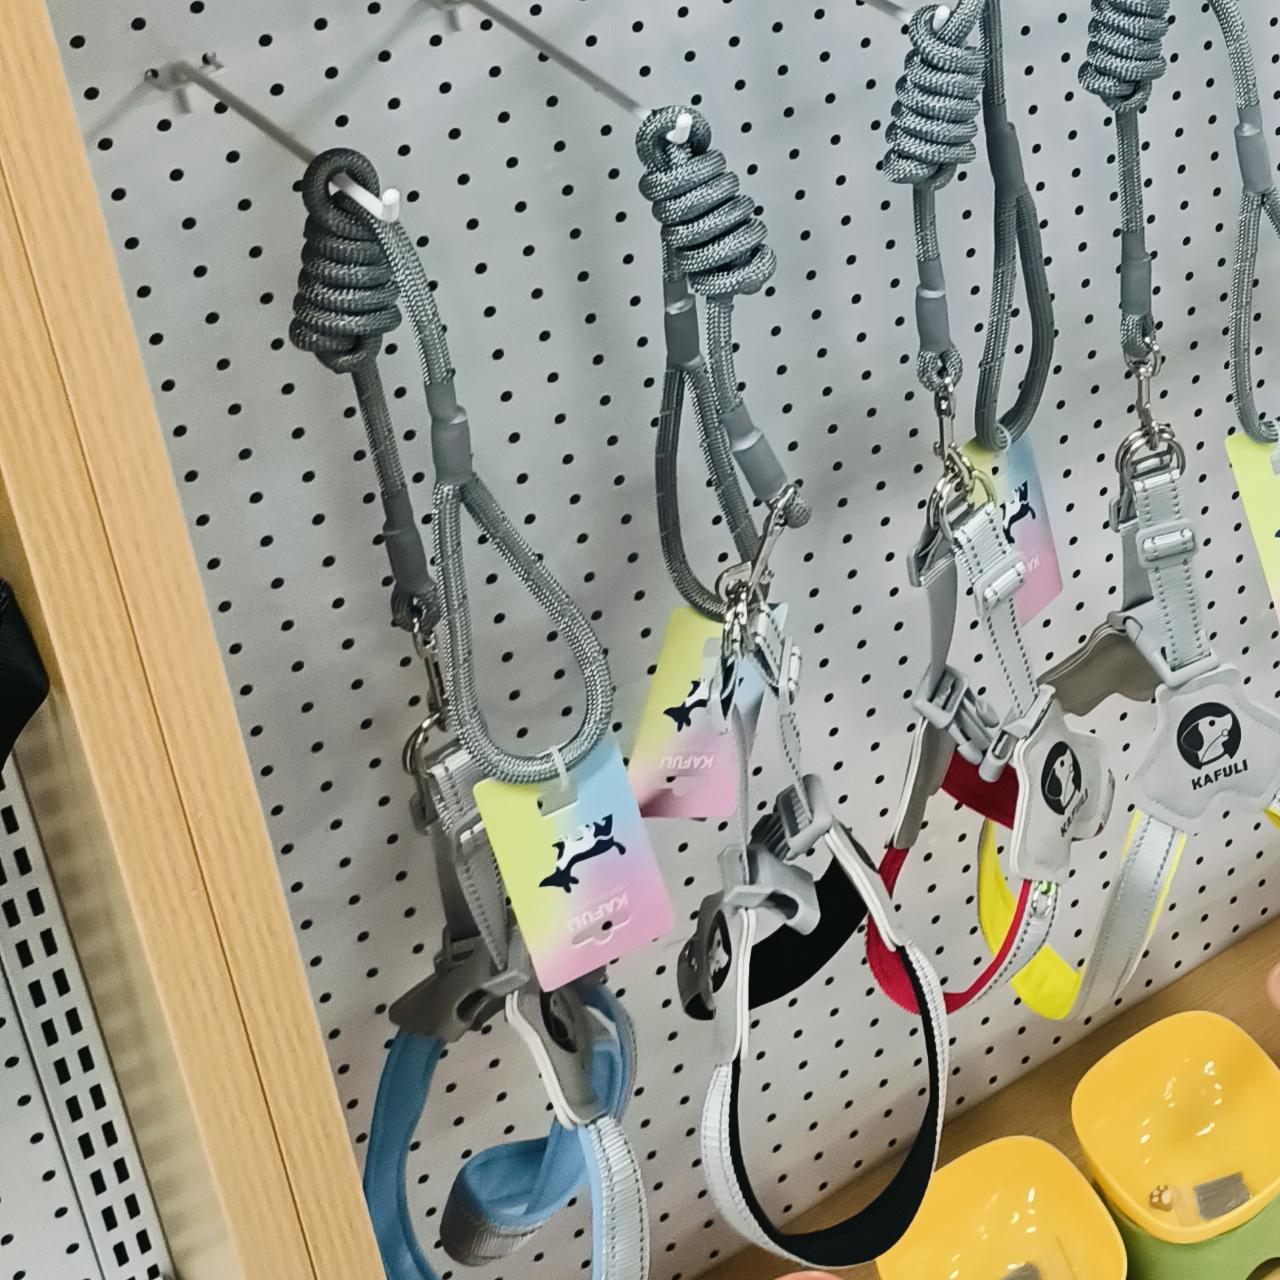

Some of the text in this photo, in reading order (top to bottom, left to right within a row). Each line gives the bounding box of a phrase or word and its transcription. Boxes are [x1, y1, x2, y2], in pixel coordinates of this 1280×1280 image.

[659, 754, 714, 770] KAFULI
[1191, 758, 1249, 790] KAFULI
[568, 893, 629, 933] KAFULI
